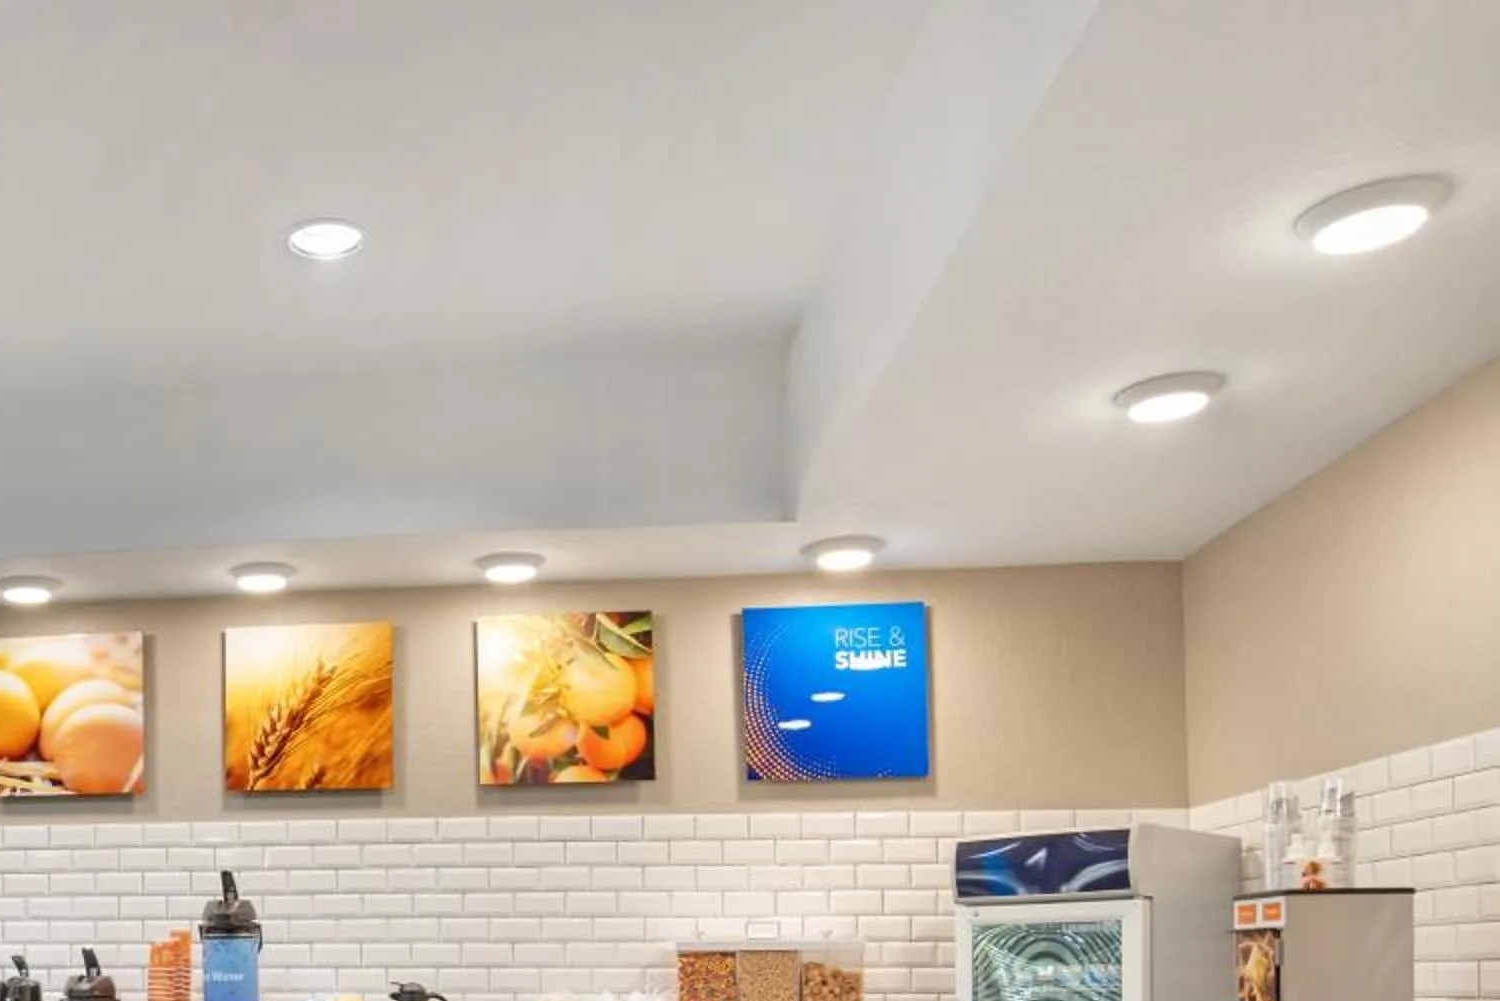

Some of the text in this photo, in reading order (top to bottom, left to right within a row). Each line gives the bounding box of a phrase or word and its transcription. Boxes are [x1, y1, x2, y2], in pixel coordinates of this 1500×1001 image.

[835, 625, 906, 648] RISE &
[835, 649, 907, 670] SHINE
